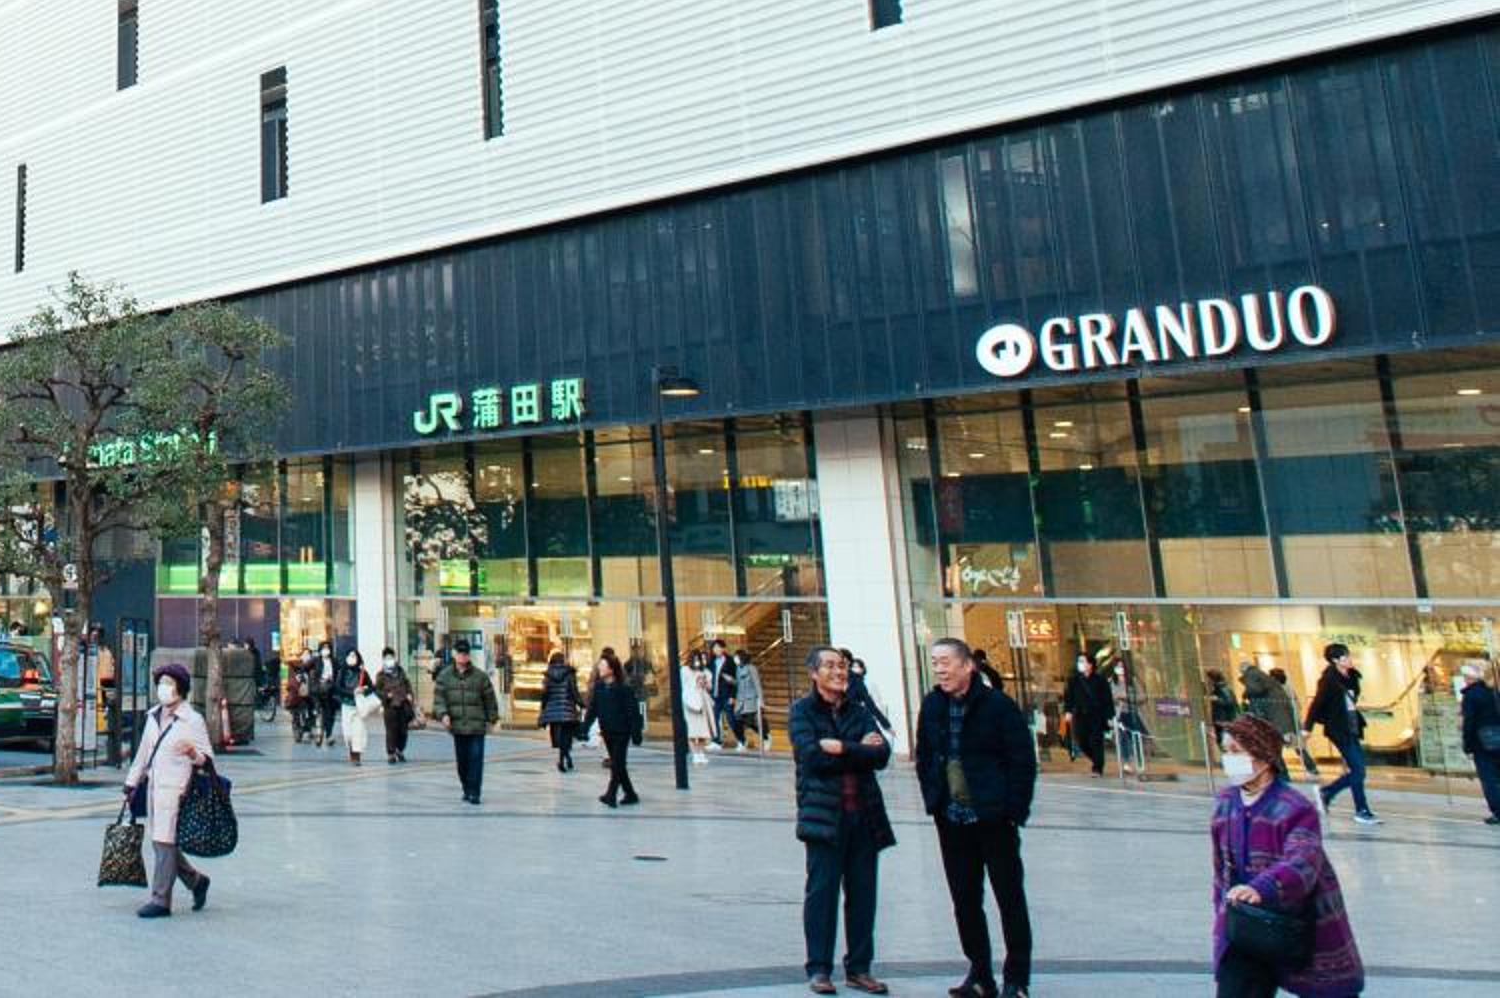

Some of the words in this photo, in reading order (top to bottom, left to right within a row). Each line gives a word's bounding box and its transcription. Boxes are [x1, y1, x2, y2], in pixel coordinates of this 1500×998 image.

[1038, 284, 1337, 373] GRANDUO
[413, 392, 463, 435] JR
[472, 377, 586, 428] 蒲田駅
